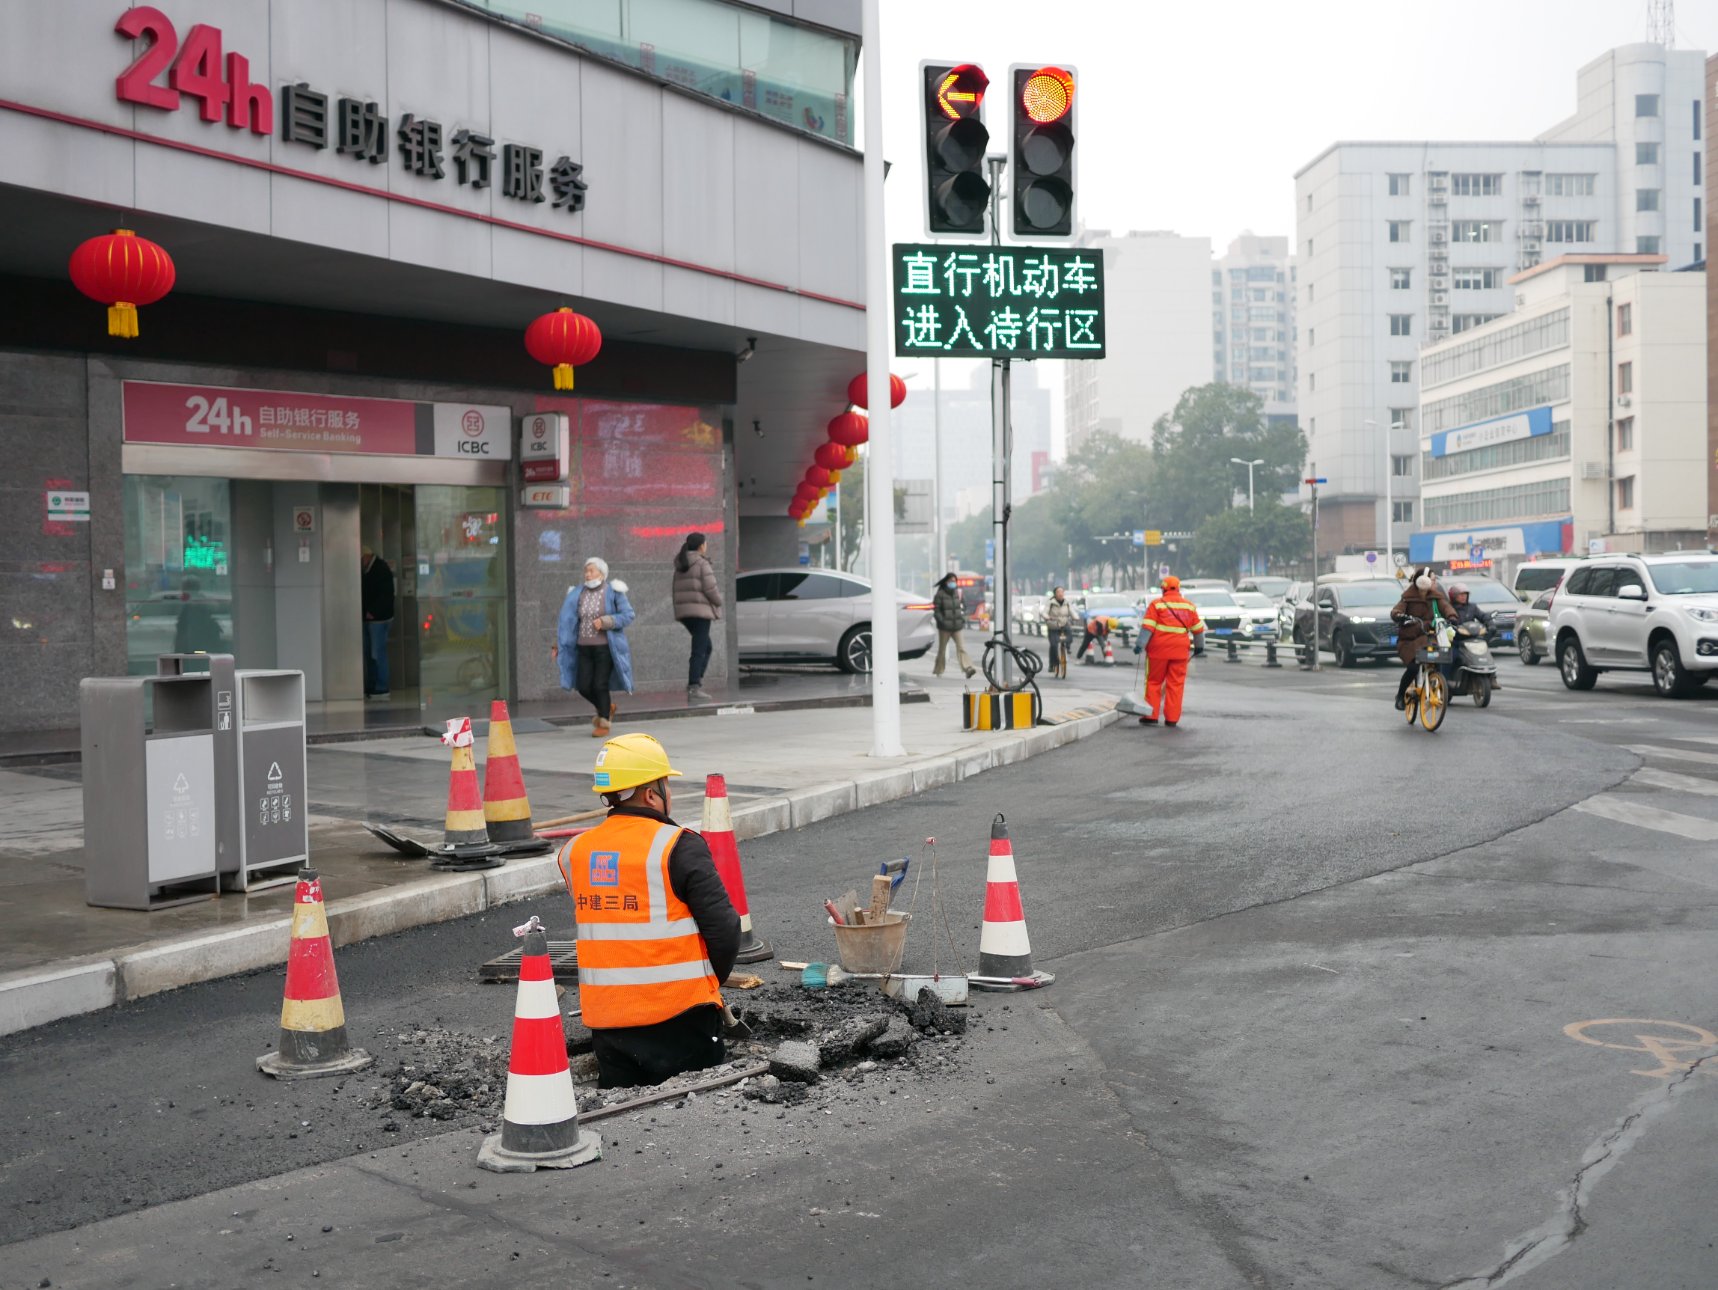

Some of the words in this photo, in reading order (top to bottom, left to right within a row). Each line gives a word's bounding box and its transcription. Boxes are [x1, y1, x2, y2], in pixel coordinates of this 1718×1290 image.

[114, 5, 273, 136] 24h
[281, 82, 589, 212] 自助银行服务
[901, 251, 1098, 298] 直行机动车
[901, 304, 1102, 350] 进入待行区
[185, 395, 252, 436] 24h
[259, 405, 361, 430] 自助银行服务
[260, 428, 321, 441] Self-Service
[322, 431, 362, 445] Banking
[457, 440, 490, 454] ICBC
[531, 441, 547, 451] ICBC
[532, 492, 553, 501] ETC
[577, 894, 639, 912] 中建三局
